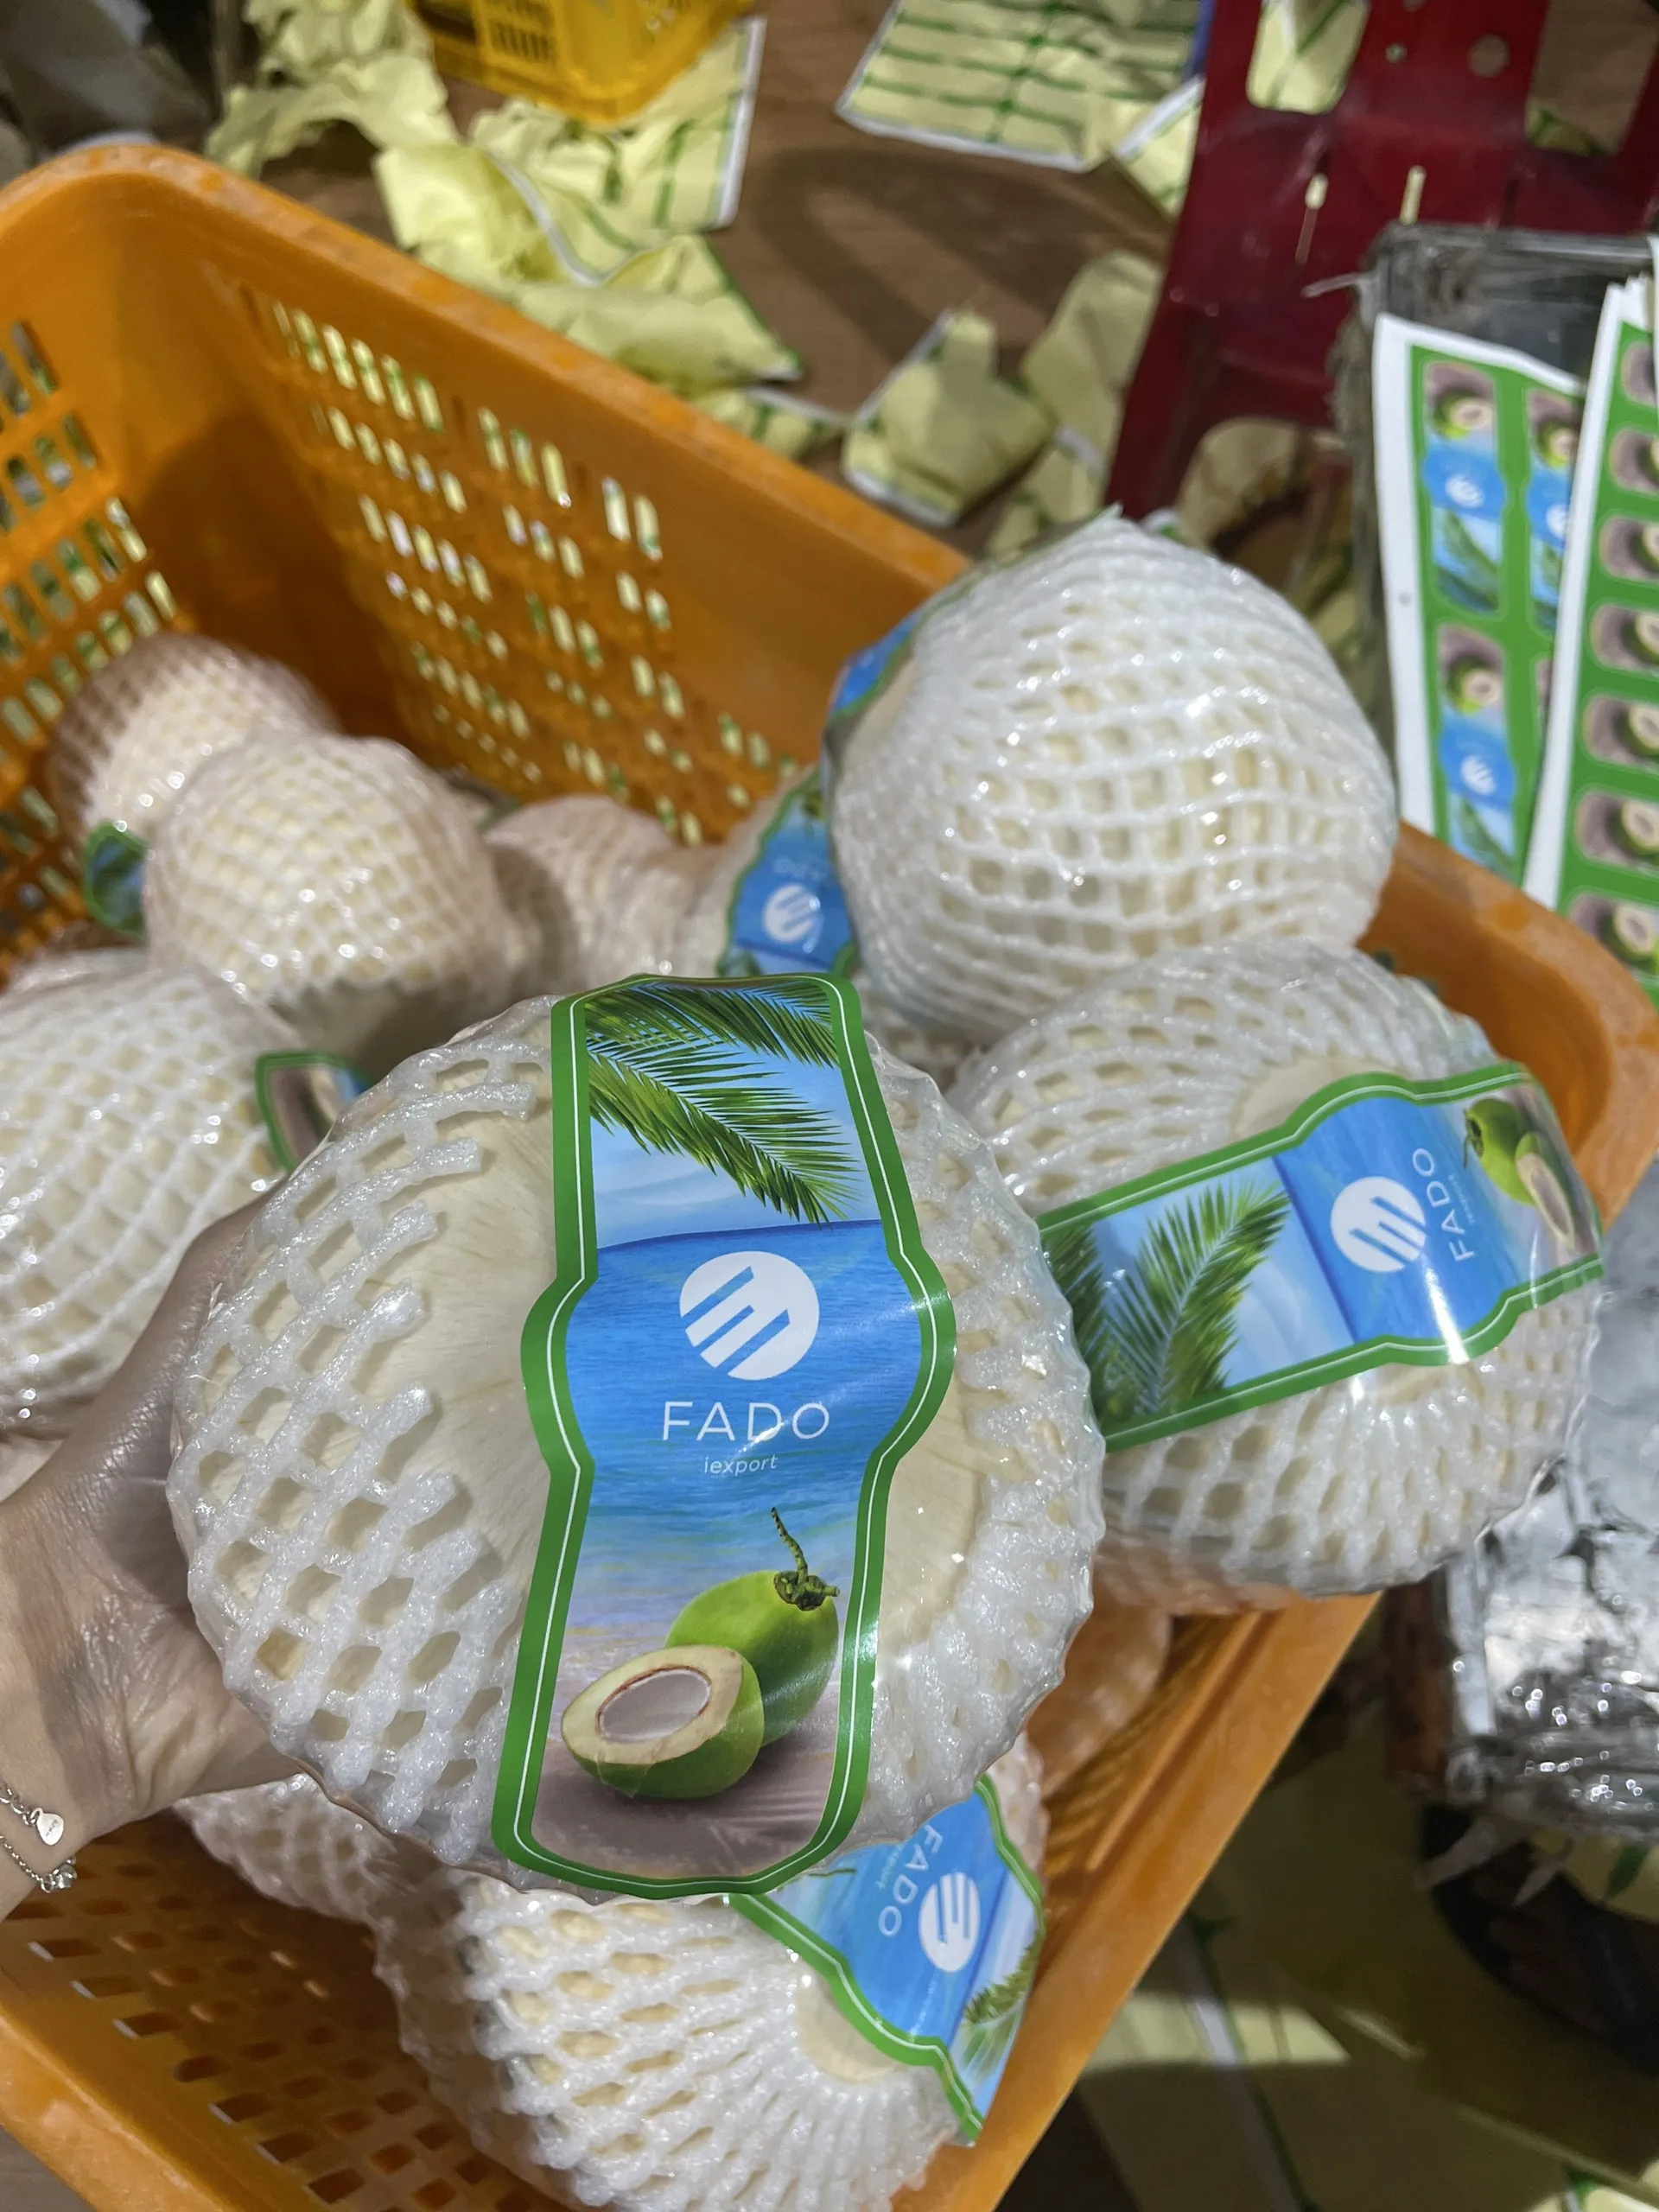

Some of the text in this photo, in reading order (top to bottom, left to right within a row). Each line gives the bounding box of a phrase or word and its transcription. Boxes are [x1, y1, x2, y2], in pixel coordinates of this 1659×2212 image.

[1412, 1147, 1474, 1262] FADO
[662, 1401, 830, 1441] FADO
[703, 1453, 779, 1477] iexport
[877, 1823, 944, 1936] FADO
